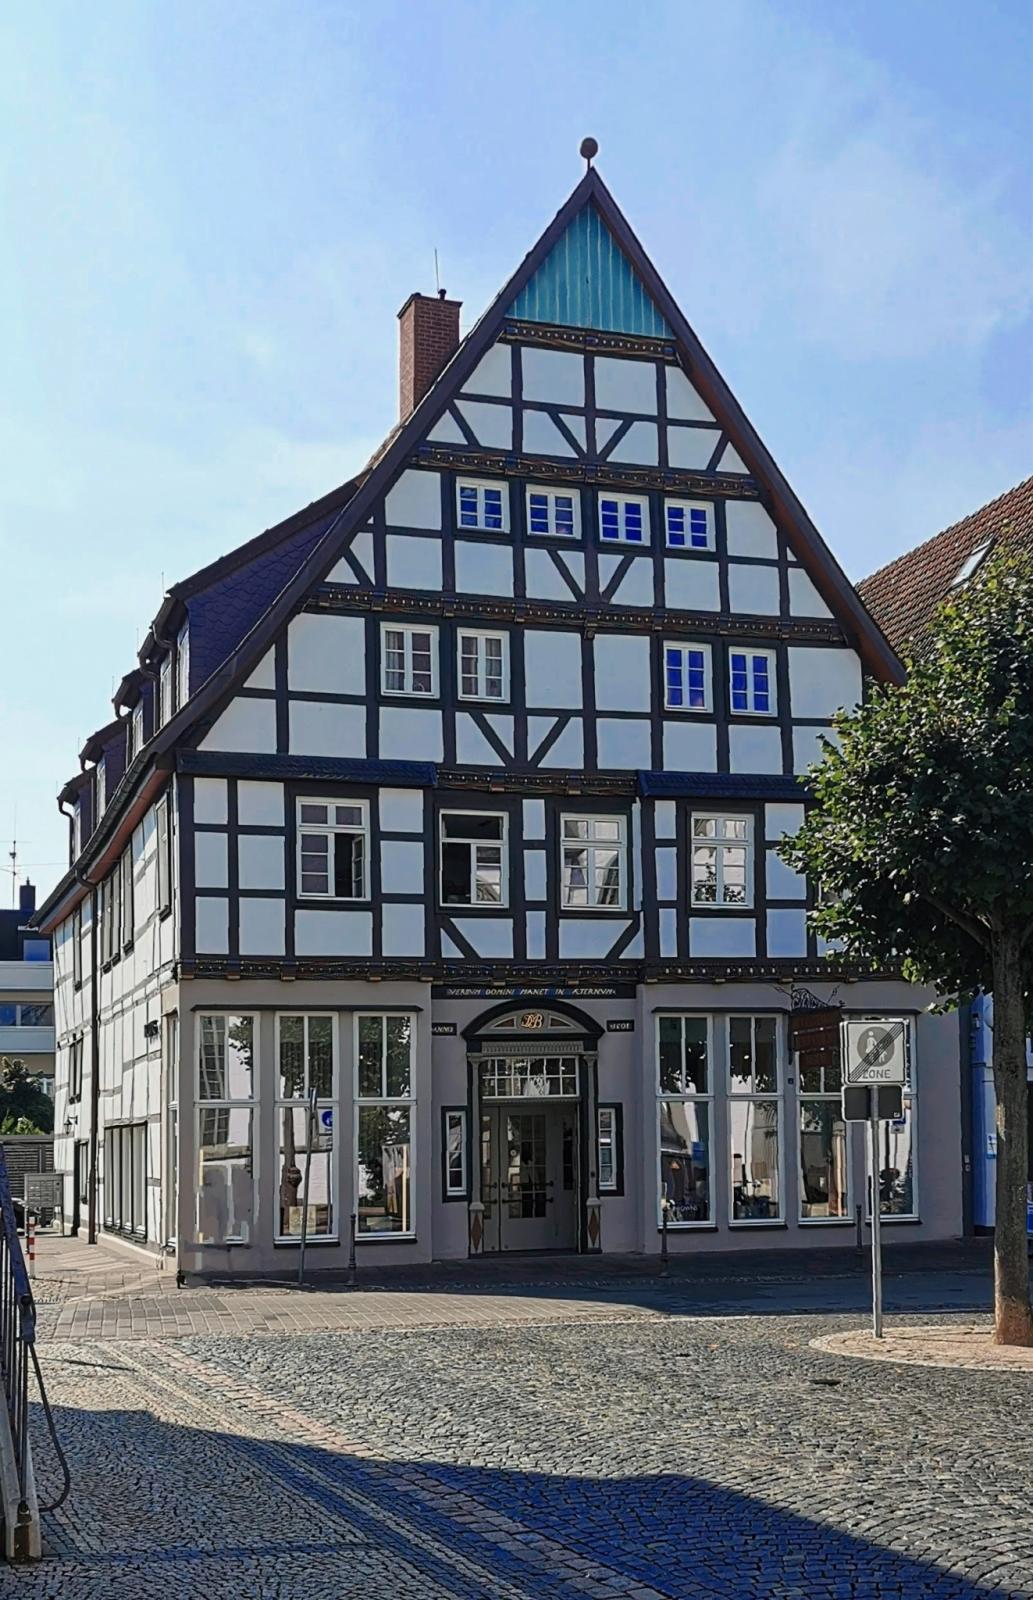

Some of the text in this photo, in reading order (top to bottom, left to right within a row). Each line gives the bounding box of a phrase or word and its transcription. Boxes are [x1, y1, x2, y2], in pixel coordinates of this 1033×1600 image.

[485, 988, 514, 996] DOMINI
[519, 988, 548, 996] MANET
[555, 988, 565, 996] IN
